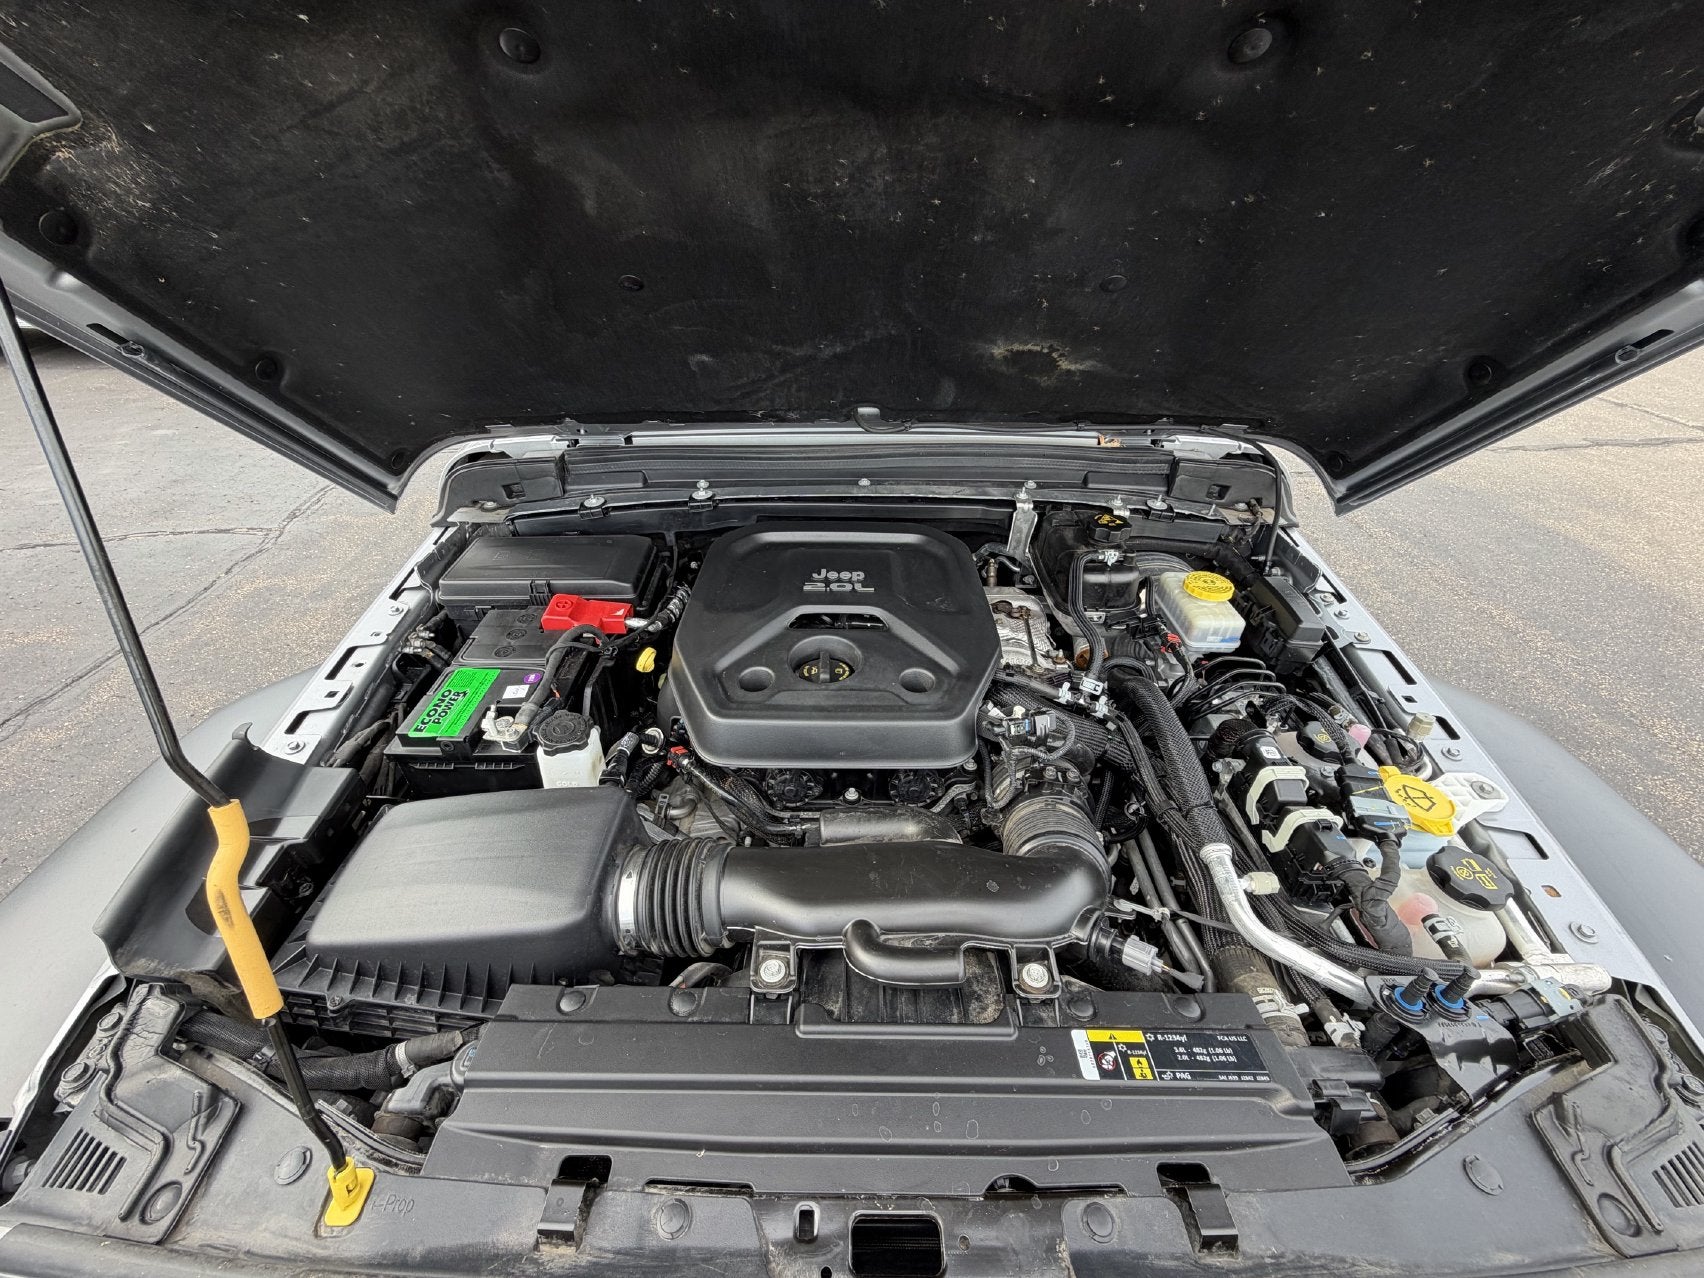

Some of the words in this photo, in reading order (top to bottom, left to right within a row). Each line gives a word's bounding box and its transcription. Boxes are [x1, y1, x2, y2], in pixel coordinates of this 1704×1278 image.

[812, 568, 865, 582] Jeep
[803, 582, 874, 592] 2.0L
[414, 688, 452, 732] ECONO
[432, 690, 466, 724] POWER
[1175, 1072, 1191, 1080] PAG
[383, 1192, 415, 1217] Prop
